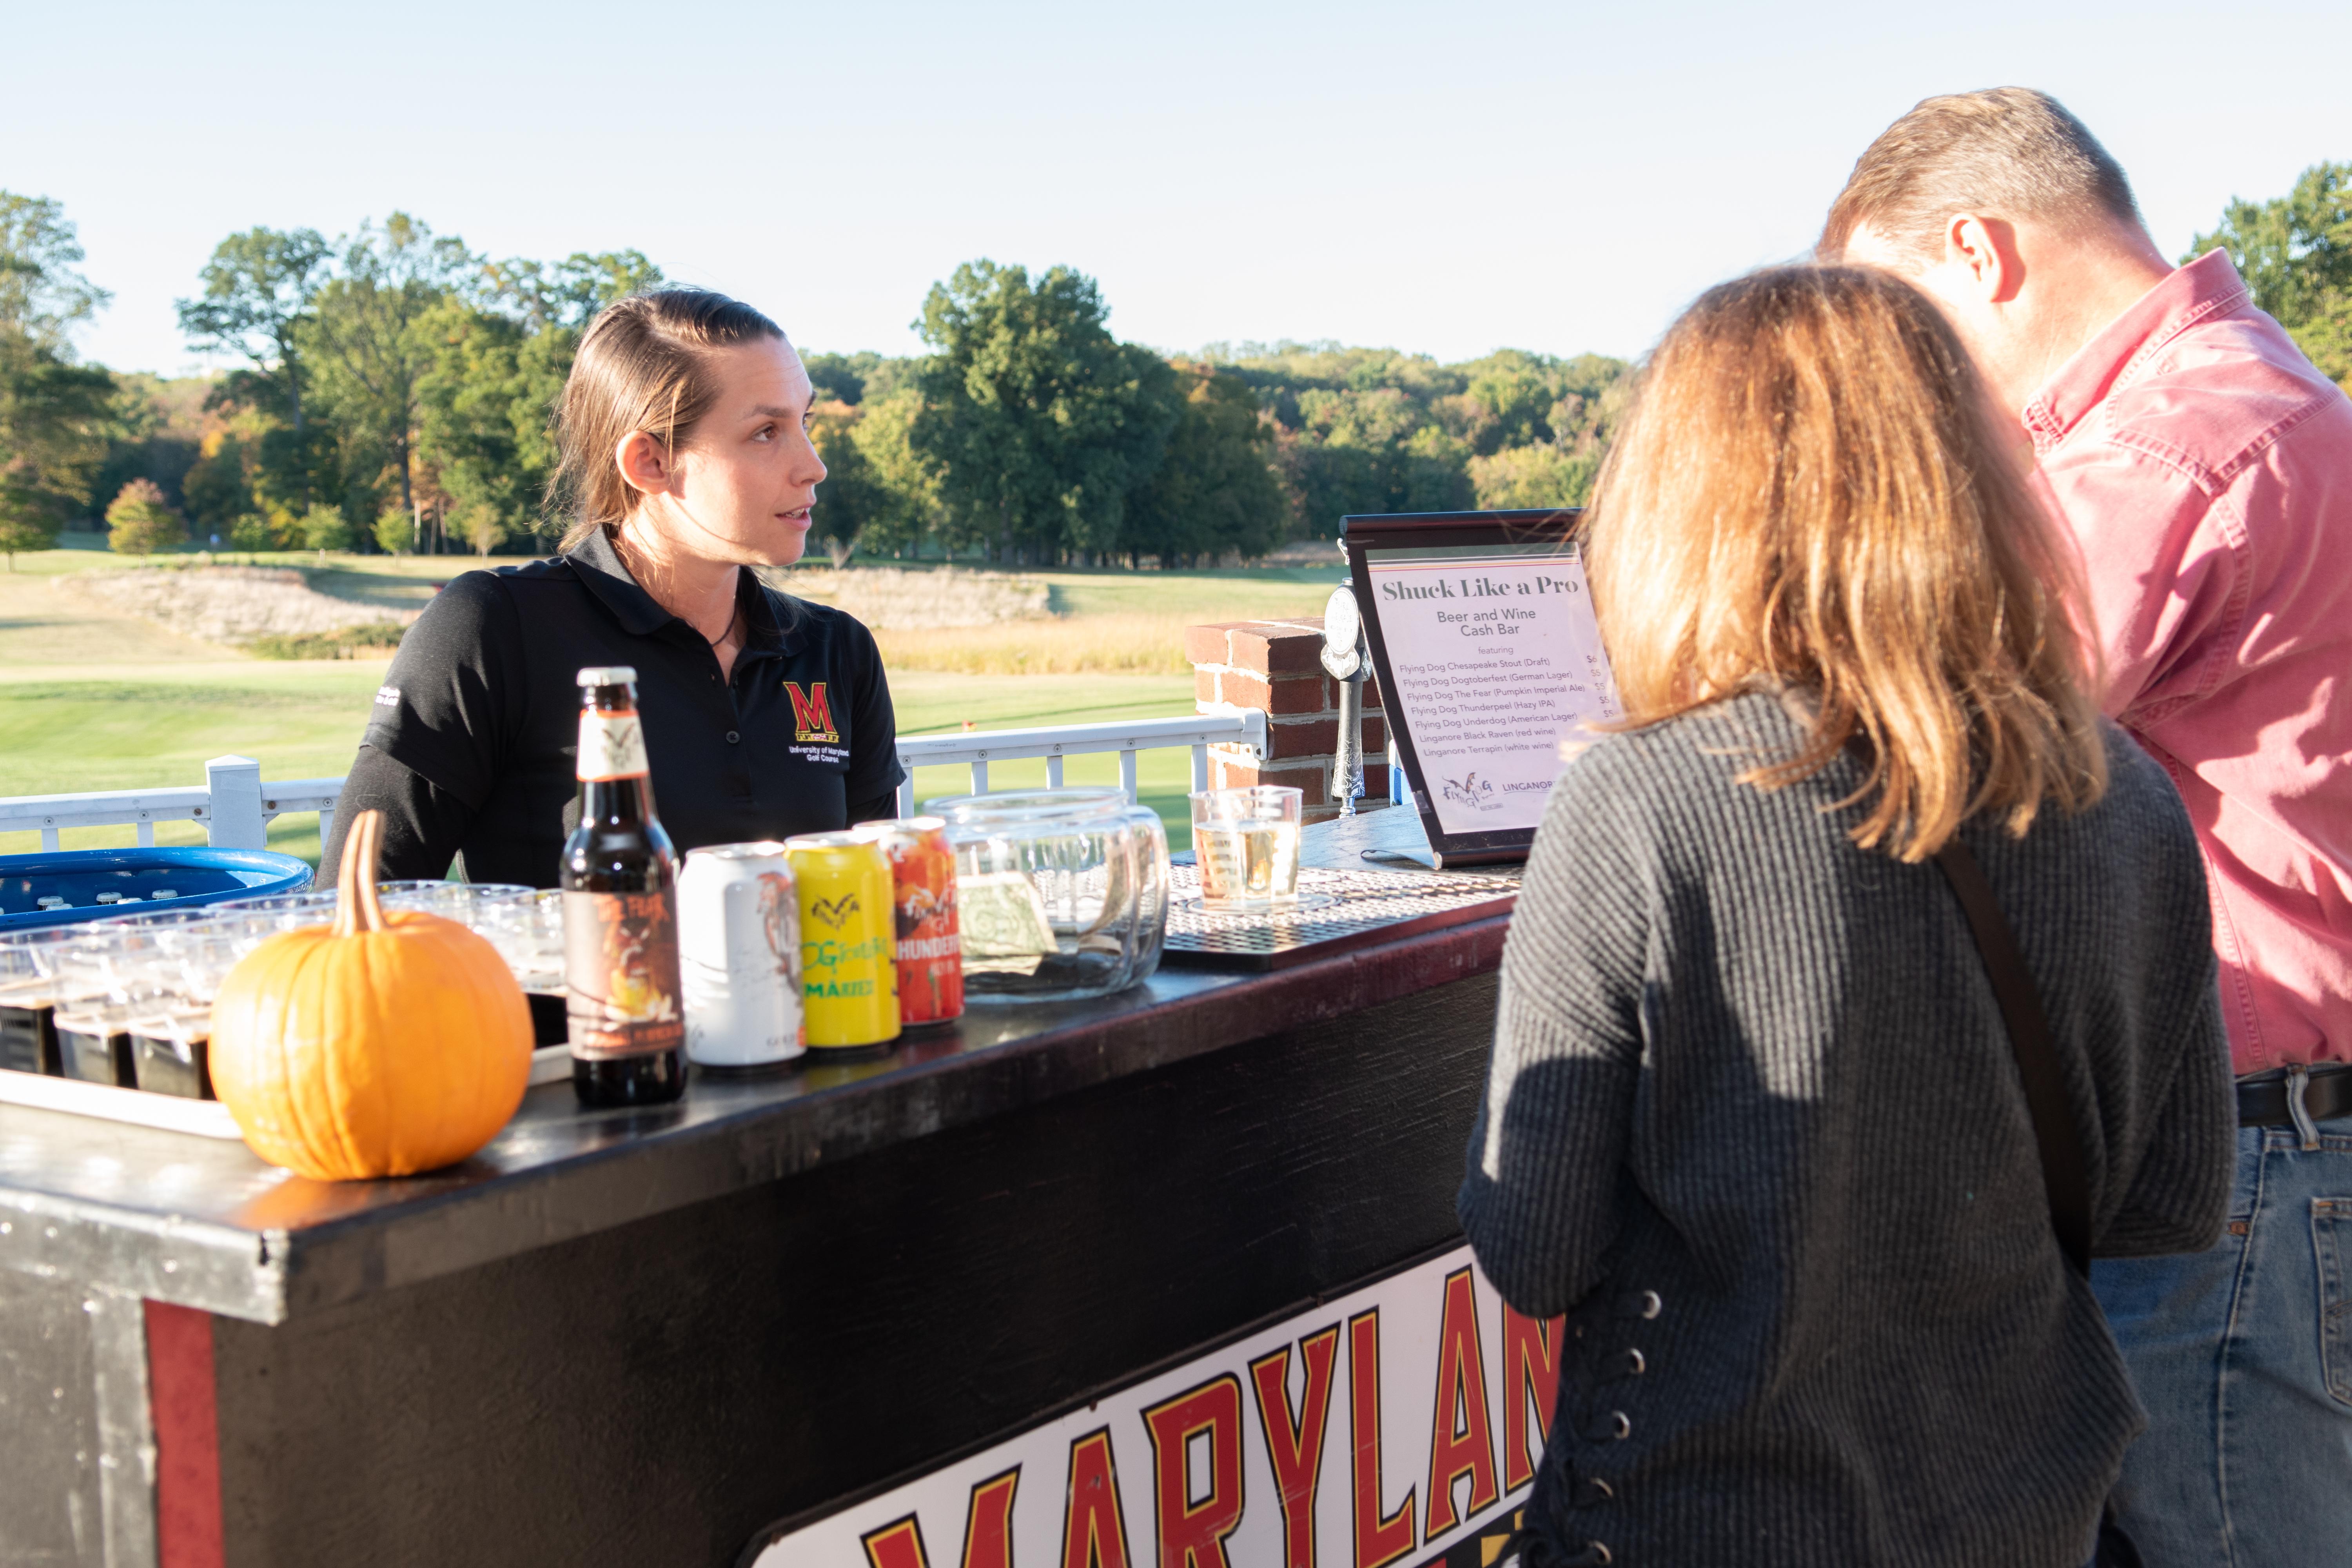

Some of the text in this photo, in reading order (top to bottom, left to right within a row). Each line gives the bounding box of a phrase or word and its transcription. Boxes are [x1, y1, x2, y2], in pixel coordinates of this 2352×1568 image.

[1382, 576, 1579, 600] Shuck Like a Pro
[1437, 608, 1536, 623] Beer and Wine
[1460, 623, 1520, 637] Cash Bar
[1478, 646, 1514, 655] featuring
[1399, 664, 1425, 674] Flying
[1427, 663, 1446, 673] Dog
[1447, 660, 1498, 671] Chesapeake
[1524, 657, 1550, 667] (Draft)
[1586, 655, 1597, 663] $6
[1403, 669, 1601, 688] Flying Dog Dogtoberfest (German Lager) $5
[1407, 693, 1433, 702] Flying
[1434, 691, 1454, 701] Dog
[1494, 687, 1532, 697] (Pumpkin
[1534, 684, 1567, 695] Imperial
[1569, 684, 1585, 692] Ale)
[783, 681, 838, 735] M
[1411, 696, 1610, 716] Flying Dog Thunderpeel (Hazy IPA) $5
[1415, 710, 1614, 730] Flying Dog Underdog (American Lager) $5
[1419, 727, 1556, 744] Linganore Black Raven (red wine)
[789, 745, 820, 754] University
[828, 746, 849, 757] Maryland
[1423, 741, 1554, 757] Linganore Terrapin (white wine)
[821, 754, 839, 763] Course
[1502, 781, 1555, 791] LINGANOR
